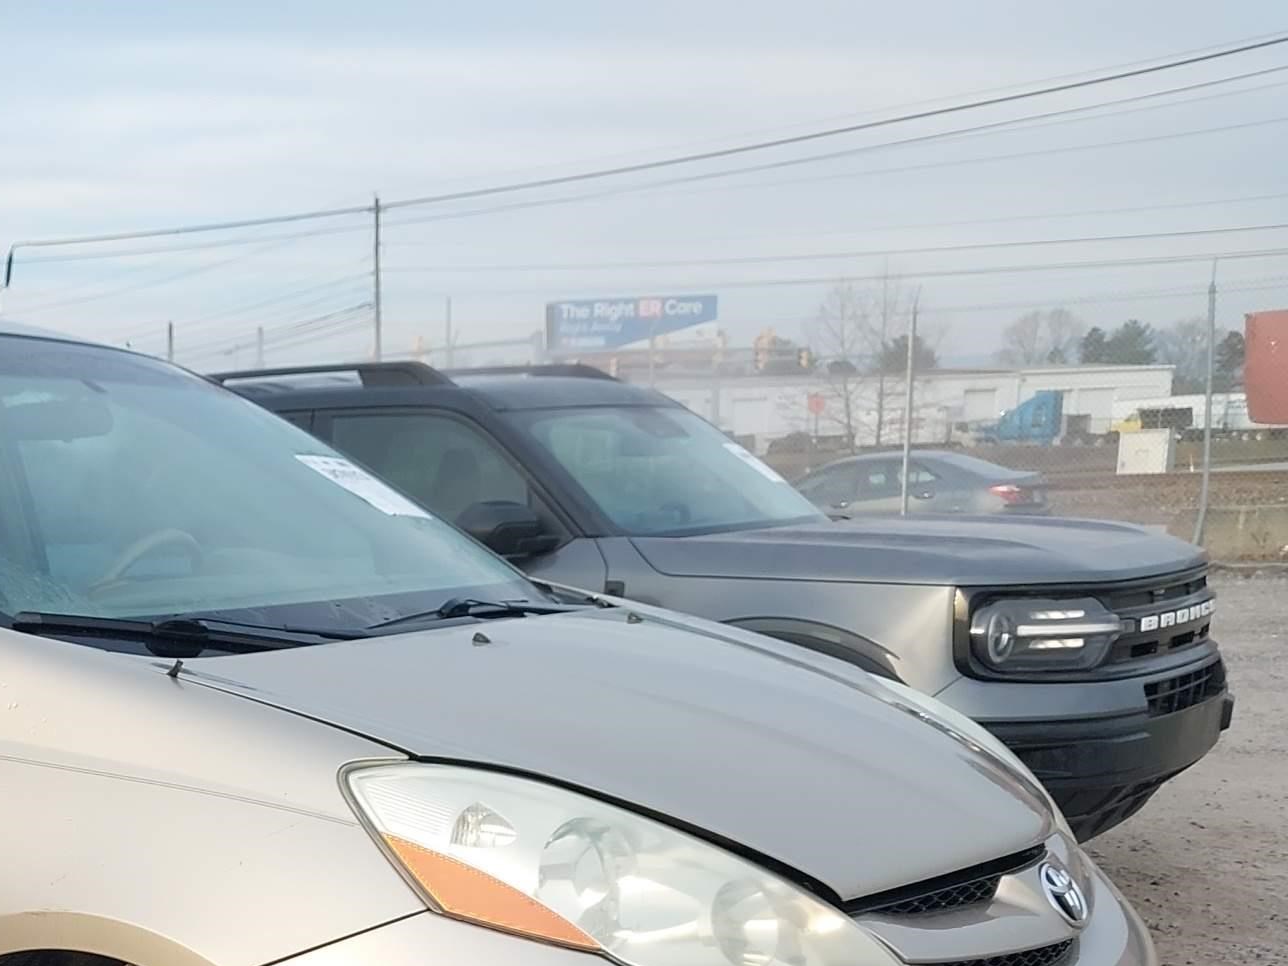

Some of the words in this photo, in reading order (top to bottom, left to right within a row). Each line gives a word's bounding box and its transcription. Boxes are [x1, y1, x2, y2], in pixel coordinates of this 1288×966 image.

[560, 304, 589, 319] The
[593, 302, 634, 321] Right
[639, 299, 662, 317] ER
[664, 299, 703, 316] Care
